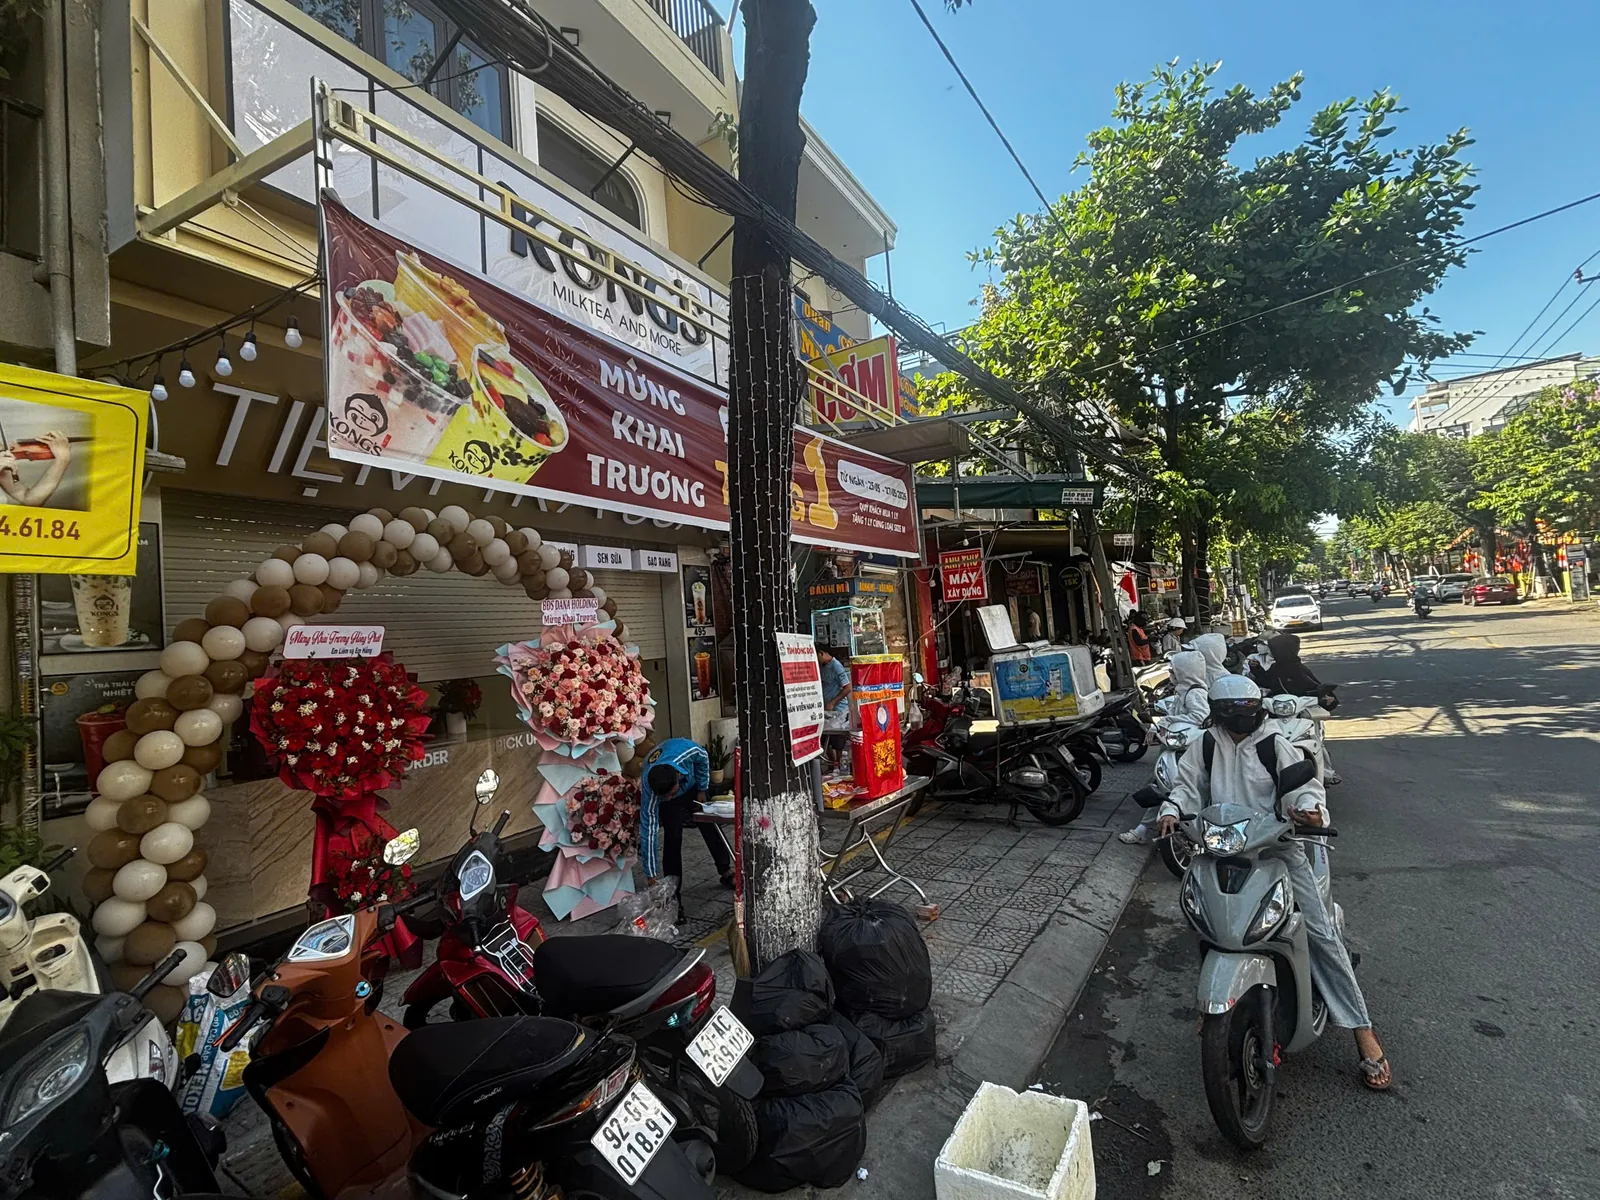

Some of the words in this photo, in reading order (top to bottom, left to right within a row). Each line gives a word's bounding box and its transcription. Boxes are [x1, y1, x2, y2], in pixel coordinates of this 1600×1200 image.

[552, 281, 614, 324] MILKTEA
[619, 315, 648, 339] AND
[650, 328, 682, 356] MORE
[599, 358, 686, 416] MỪNG
[815, 352, 888, 424] CƠM
[611, 410, 686, 459] KHAI
[587, 453, 706, 508] TRƯƠNG
[597, 552, 609, 564] SEN
[647, 556, 658, 568] GẠO
[658, 556, 671, 568] RANG
[949, 570, 977, 585] MÁY
[947, 586, 962, 599] XÂY
[962, 586, 982, 599] DỰNG
[571, 598, 598, 610] HOLDINGS
[562, 613, 576, 623] Khai
[312, 630, 329, 645] Khai
[111, 680, 130, 688] TRÁI
[102, 687, 133, 697] NHIỆT
[496, 736, 524, 753] PICK
[602, 1091, 649, 1150] 92-G1
